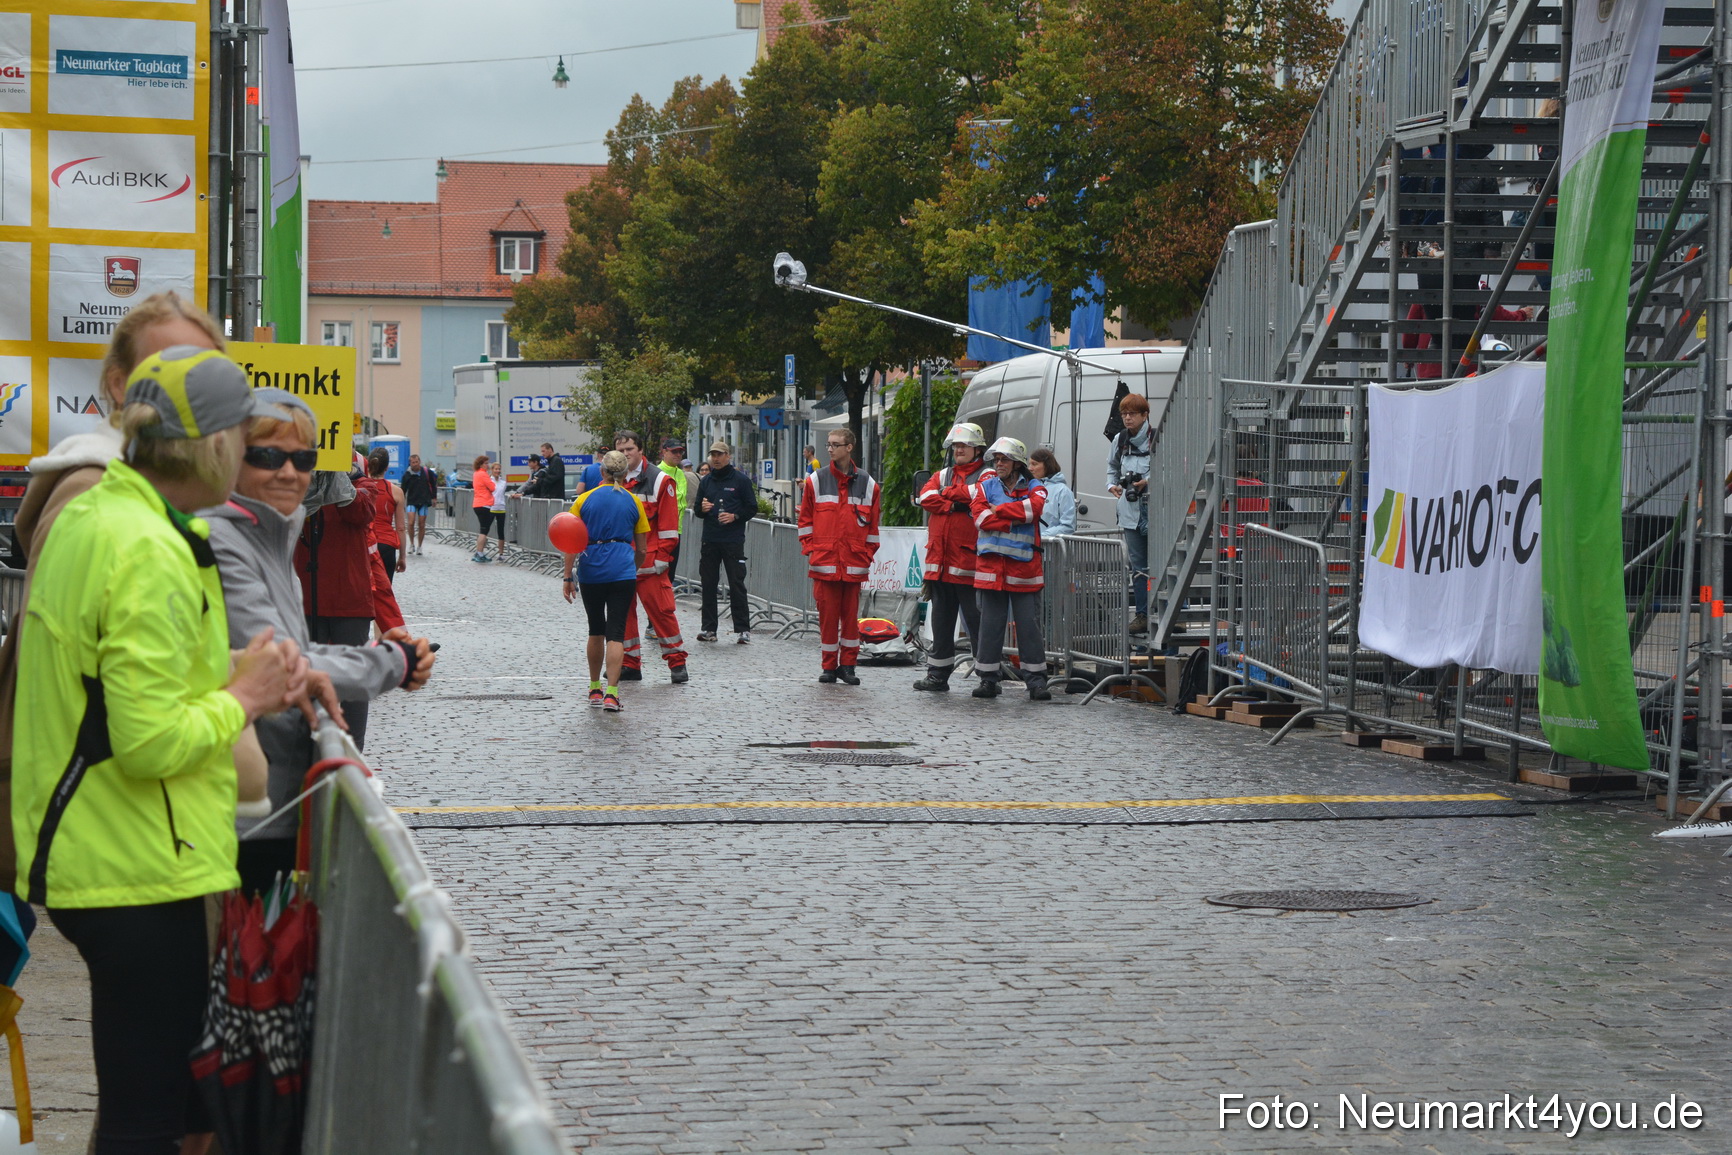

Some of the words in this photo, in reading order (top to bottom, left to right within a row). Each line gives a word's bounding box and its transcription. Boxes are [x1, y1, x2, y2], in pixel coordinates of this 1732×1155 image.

[62, 55, 131, 71] Neumarkter
[132, 58, 181, 74] Tagblatt
[0, 66, 25, 78] GL
[127, 78, 147, 87] Hier
[149, 79, 169, 88] lebe
[171, 80, 188, 89] ich.
[71, 170, 120, 186] Audi
[124, 172, 169, 188] BKK
[80, 302, 133, 316] Neuma
